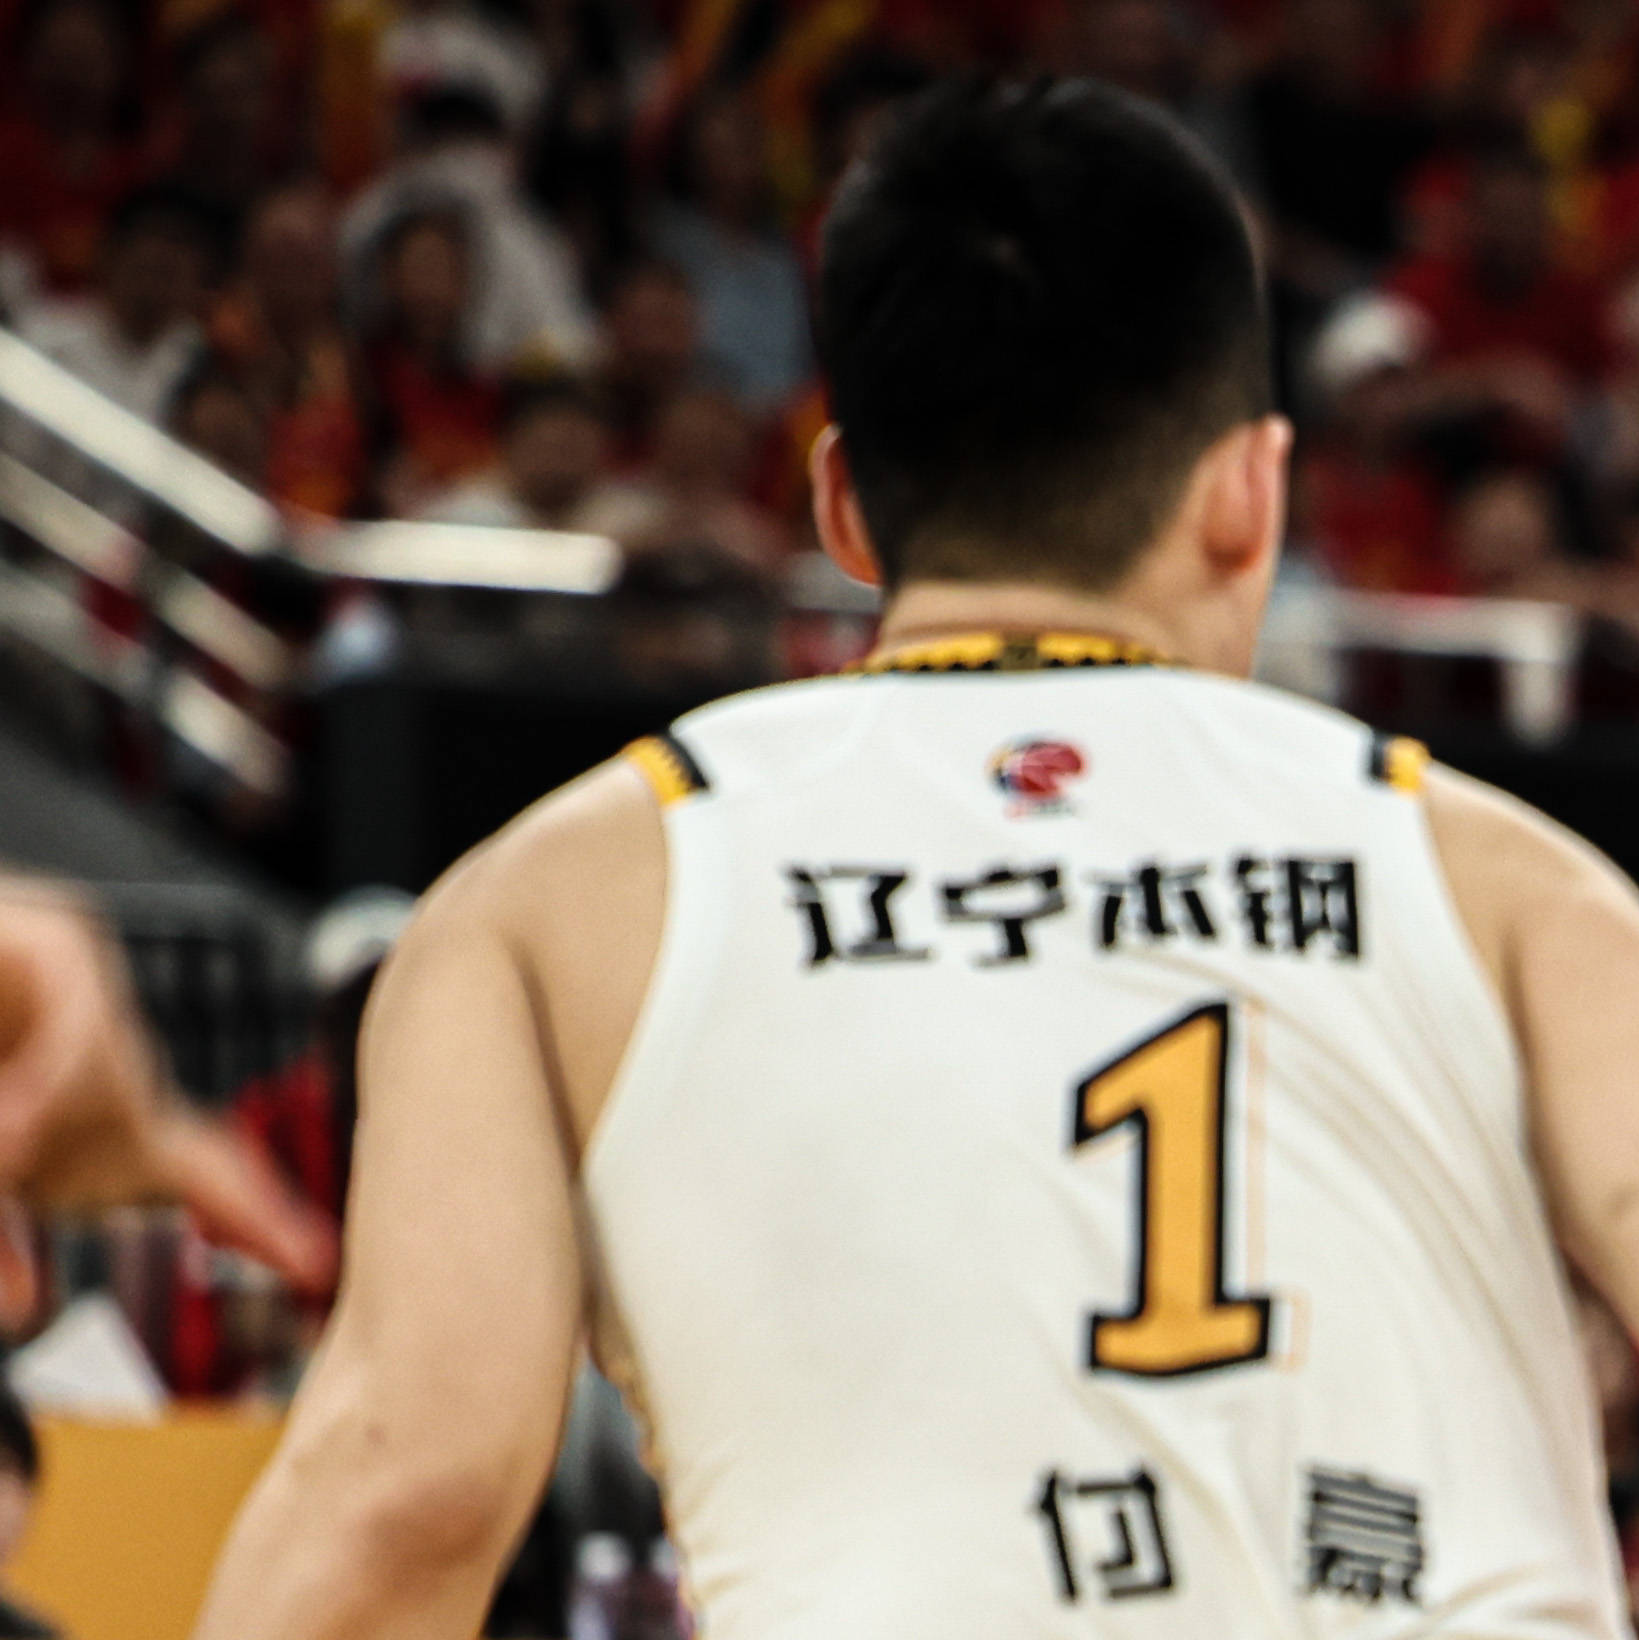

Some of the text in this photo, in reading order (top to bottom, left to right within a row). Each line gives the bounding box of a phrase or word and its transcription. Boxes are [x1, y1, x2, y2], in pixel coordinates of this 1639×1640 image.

[786, 855, 1362, 968] 辽宁本钢
[1070, 1000, 1271, 1379] 1
